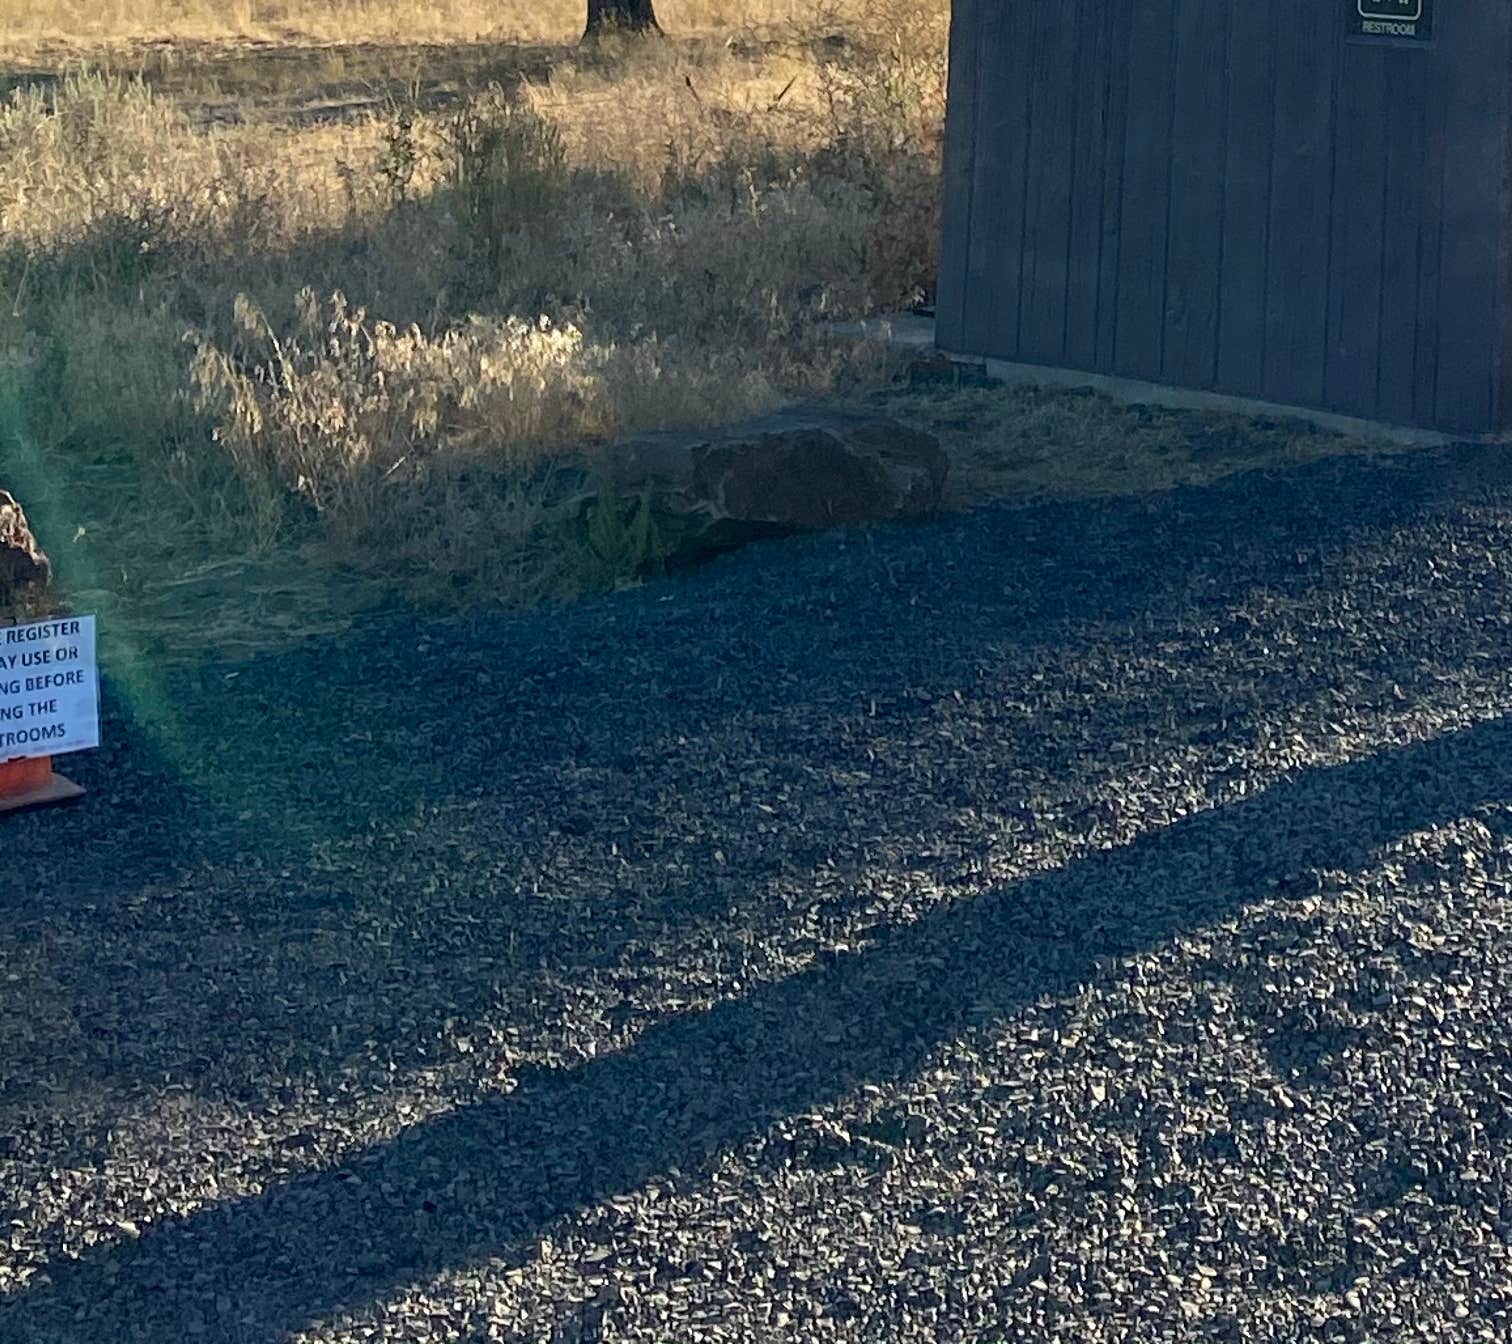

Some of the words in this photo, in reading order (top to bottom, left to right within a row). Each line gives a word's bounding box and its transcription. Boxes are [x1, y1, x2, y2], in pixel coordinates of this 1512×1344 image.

[1362, 20, 1415, 35] RESTROOM
[7, 621, 79, 644] REGISTER
[22, 650, 50, 666] USE
[56, 646, 78, 661] OR
[26, 670, 85, 691] BEFORE
[28, 699, 57, 716] THE
